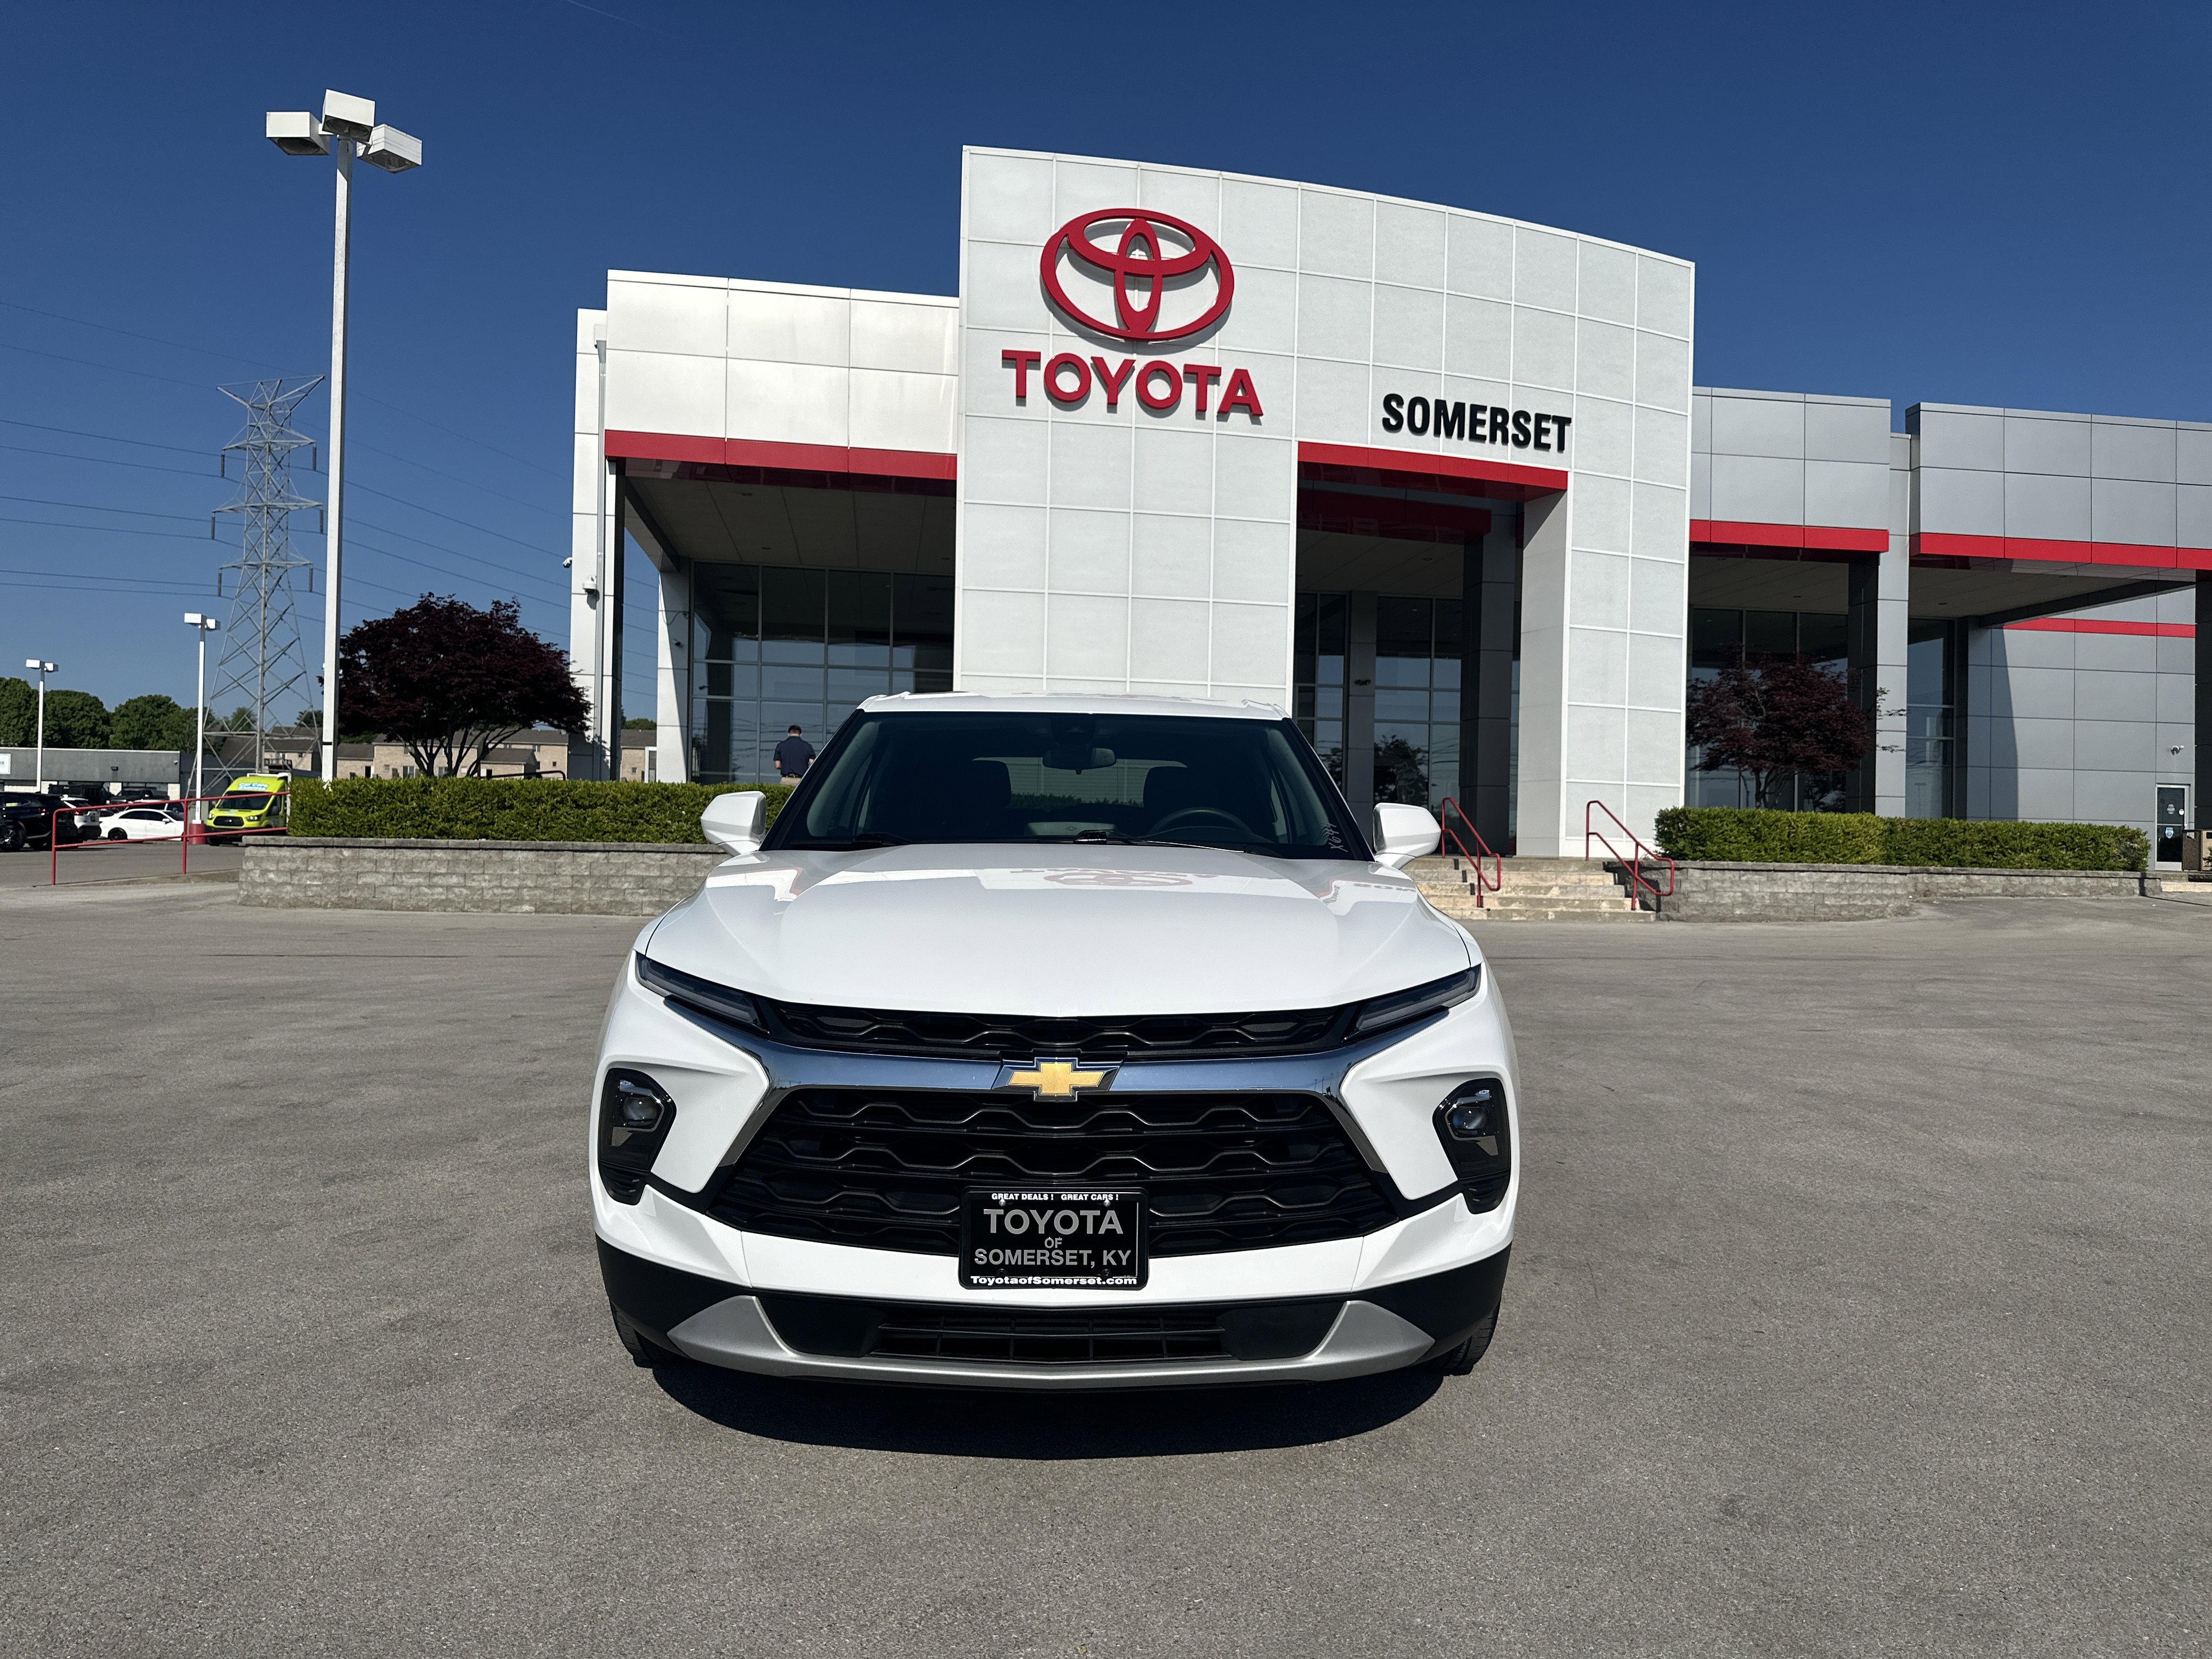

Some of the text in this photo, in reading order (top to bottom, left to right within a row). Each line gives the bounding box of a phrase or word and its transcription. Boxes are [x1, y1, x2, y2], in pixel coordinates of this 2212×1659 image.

[1002, 349, 1263, 416] TOYOTA
[1382, 393, 1572, 453] SOMERSET
[984, 1209, 1123, 1234] TOYOTA
[1045, 1237, 1062, 1248] OF
[974, 1249, 1132, 1268] SOMERSET, KY
[970, 1276, 1137, 1285] ToyotaofSomerset.com
